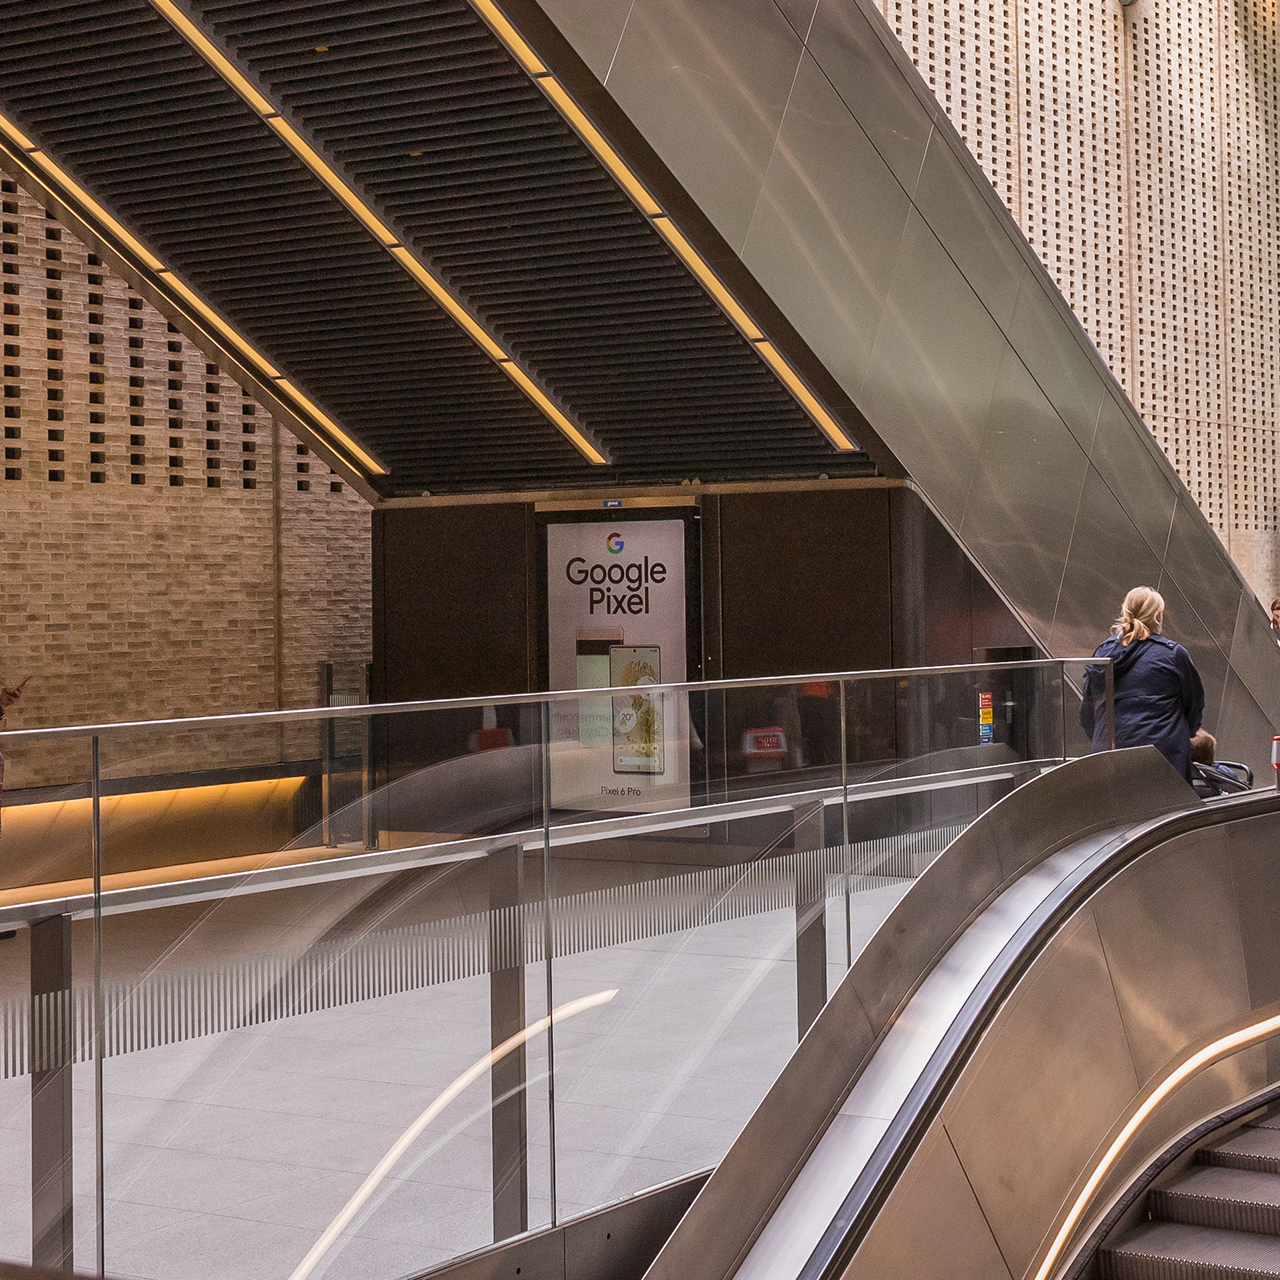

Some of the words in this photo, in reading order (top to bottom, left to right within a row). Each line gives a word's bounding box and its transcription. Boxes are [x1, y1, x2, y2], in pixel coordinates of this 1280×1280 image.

[606, 532, 625, 554] G
[566, 556, 667, 592] Google
[589, 586, 649, 614] Pixel
[601, 786, 619, 795] Pixel
[627, 787, 641, 796] Pro
